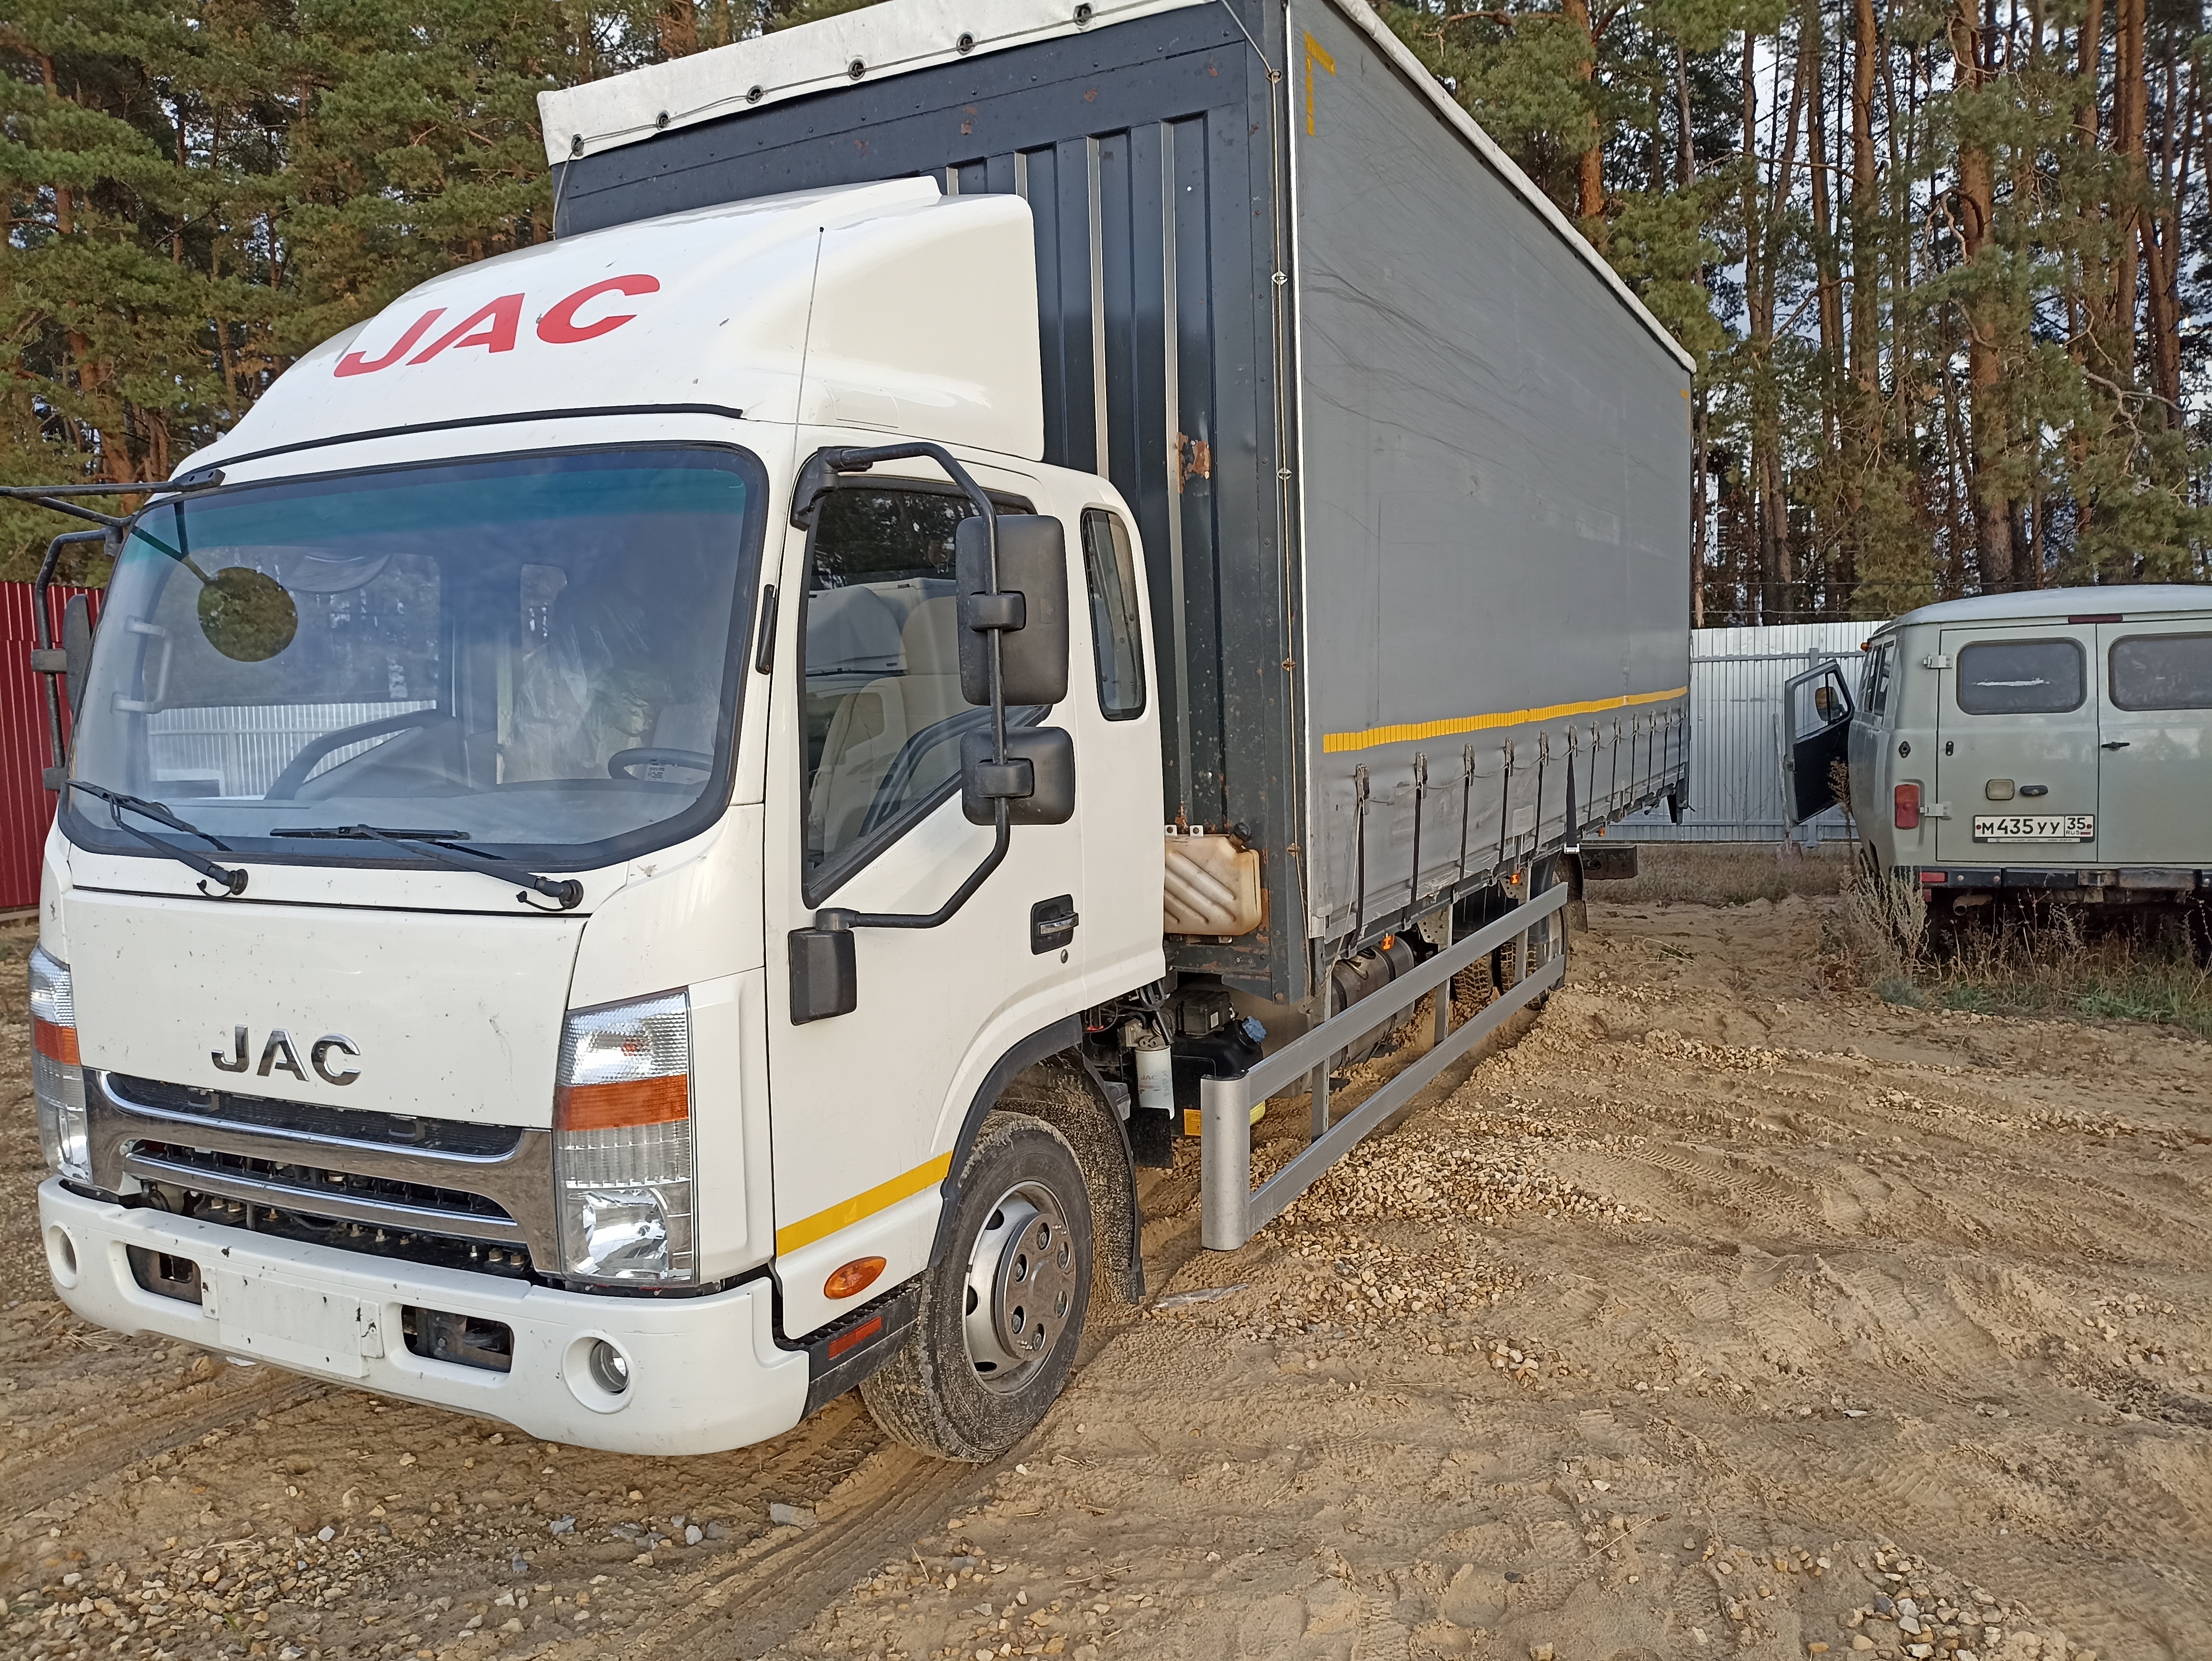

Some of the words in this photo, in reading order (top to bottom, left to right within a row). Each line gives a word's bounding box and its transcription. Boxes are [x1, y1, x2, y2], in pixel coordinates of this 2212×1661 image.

[334, 274, 660, 377] JAC
[2067, 818, 2085, 830] 35
[211, 1024, 361, 1086] JAC
